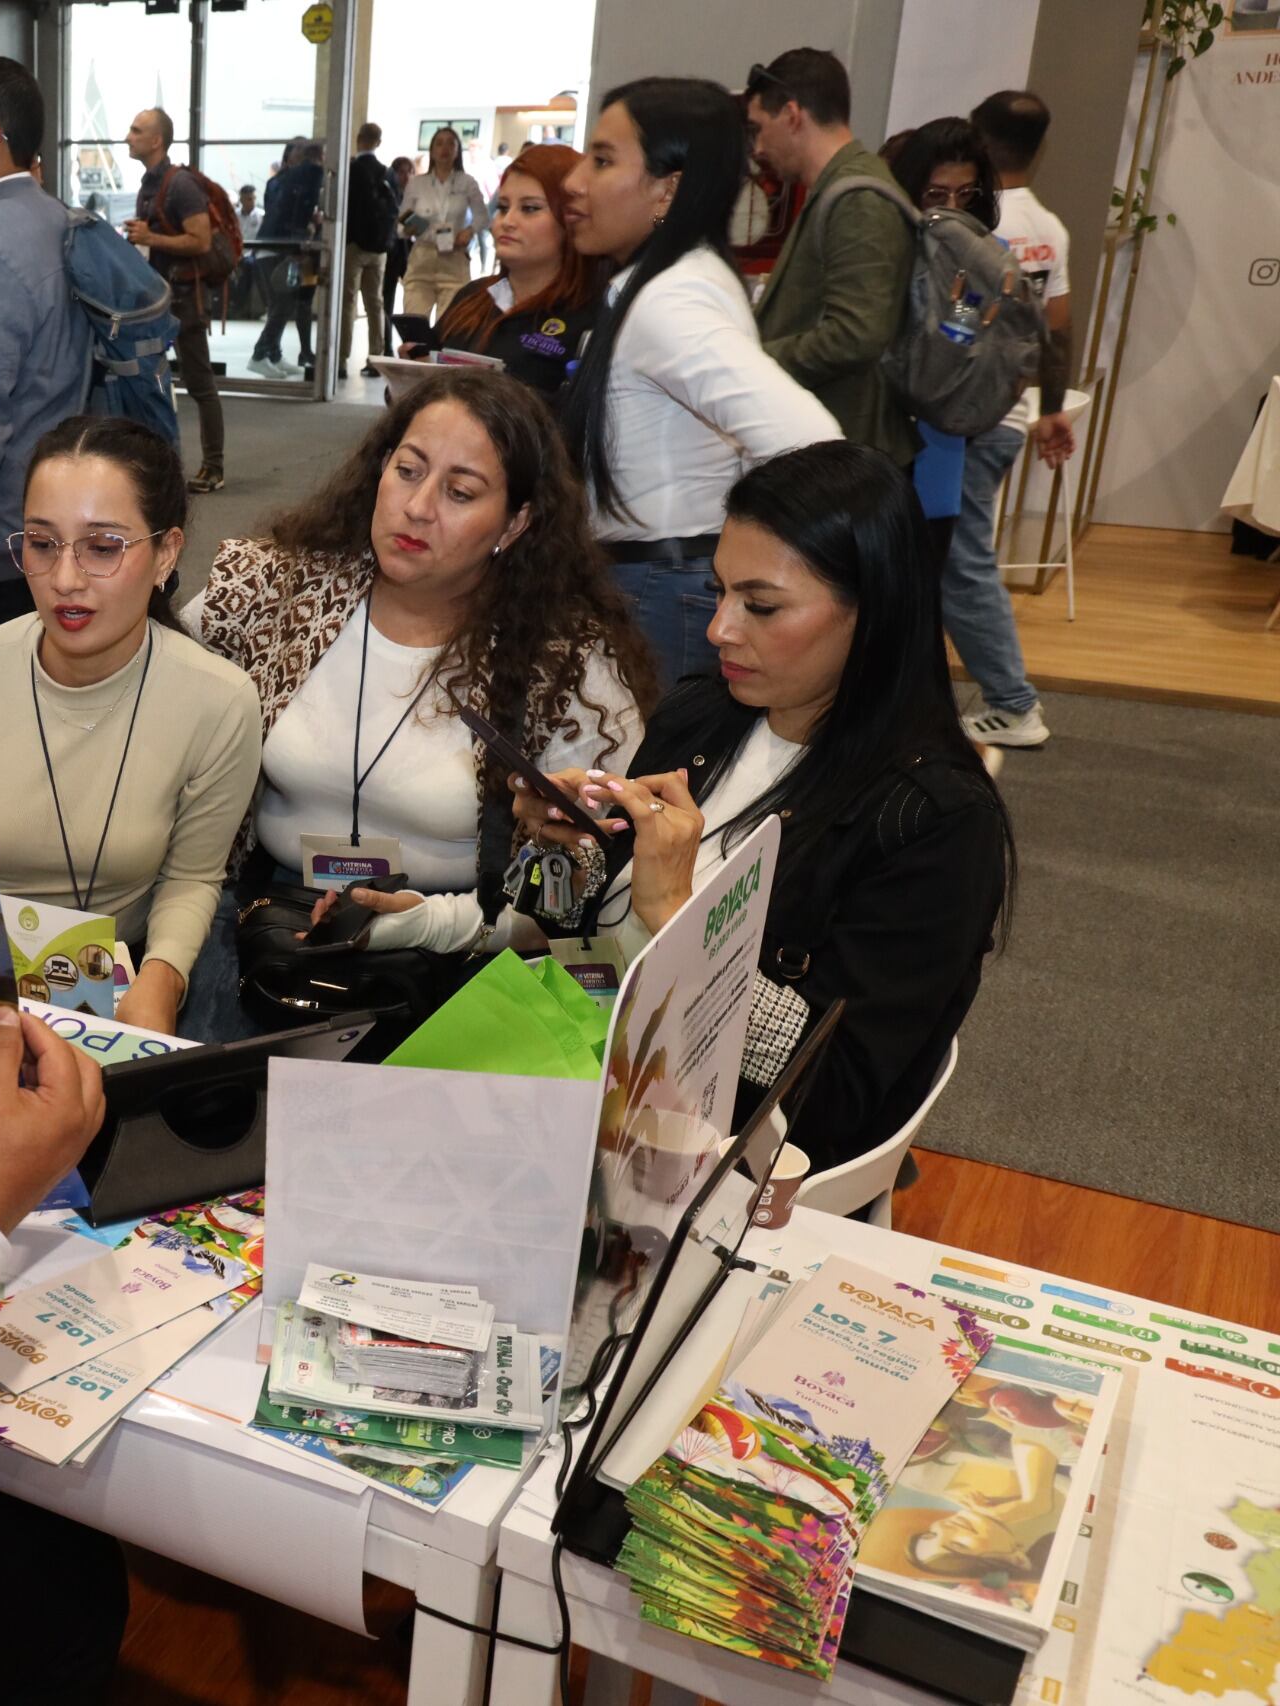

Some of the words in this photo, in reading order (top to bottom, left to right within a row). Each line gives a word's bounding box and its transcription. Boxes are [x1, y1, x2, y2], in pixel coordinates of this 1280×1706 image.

[132, 1266, 172, 1291] Boyacá
[63, 1283, 96, 1305] mundo
[837, 1281, 935, 1332] BOYACÁ
[1011, 1297, 1028, 1308] 18
[35, 1311, 57, 1324] 7
[811, 1302, 867, 1334] LOS
[877, 1330, 898, 1344] 7
[56, 1320, 96, 1347] LOS
[803, 1317, 854, 1344] Boyacá,
[857, 1341, 870, 1351] la
[873, 1348, 918, 1371] región
[1138, 1329, 1154, 1341] 17
[87, 1364, 129, 1385] Boyacá,
[855, 1355, 910, 1382] mundo
[65, 1375, 114, 1402] LOS
[496, 1376, 513, 1398] Our
[793, 1374, 856, 1409] Boyacá
[493, 1400, 513, 1417] City
[794, 1390, 839, 1415] Turismo
